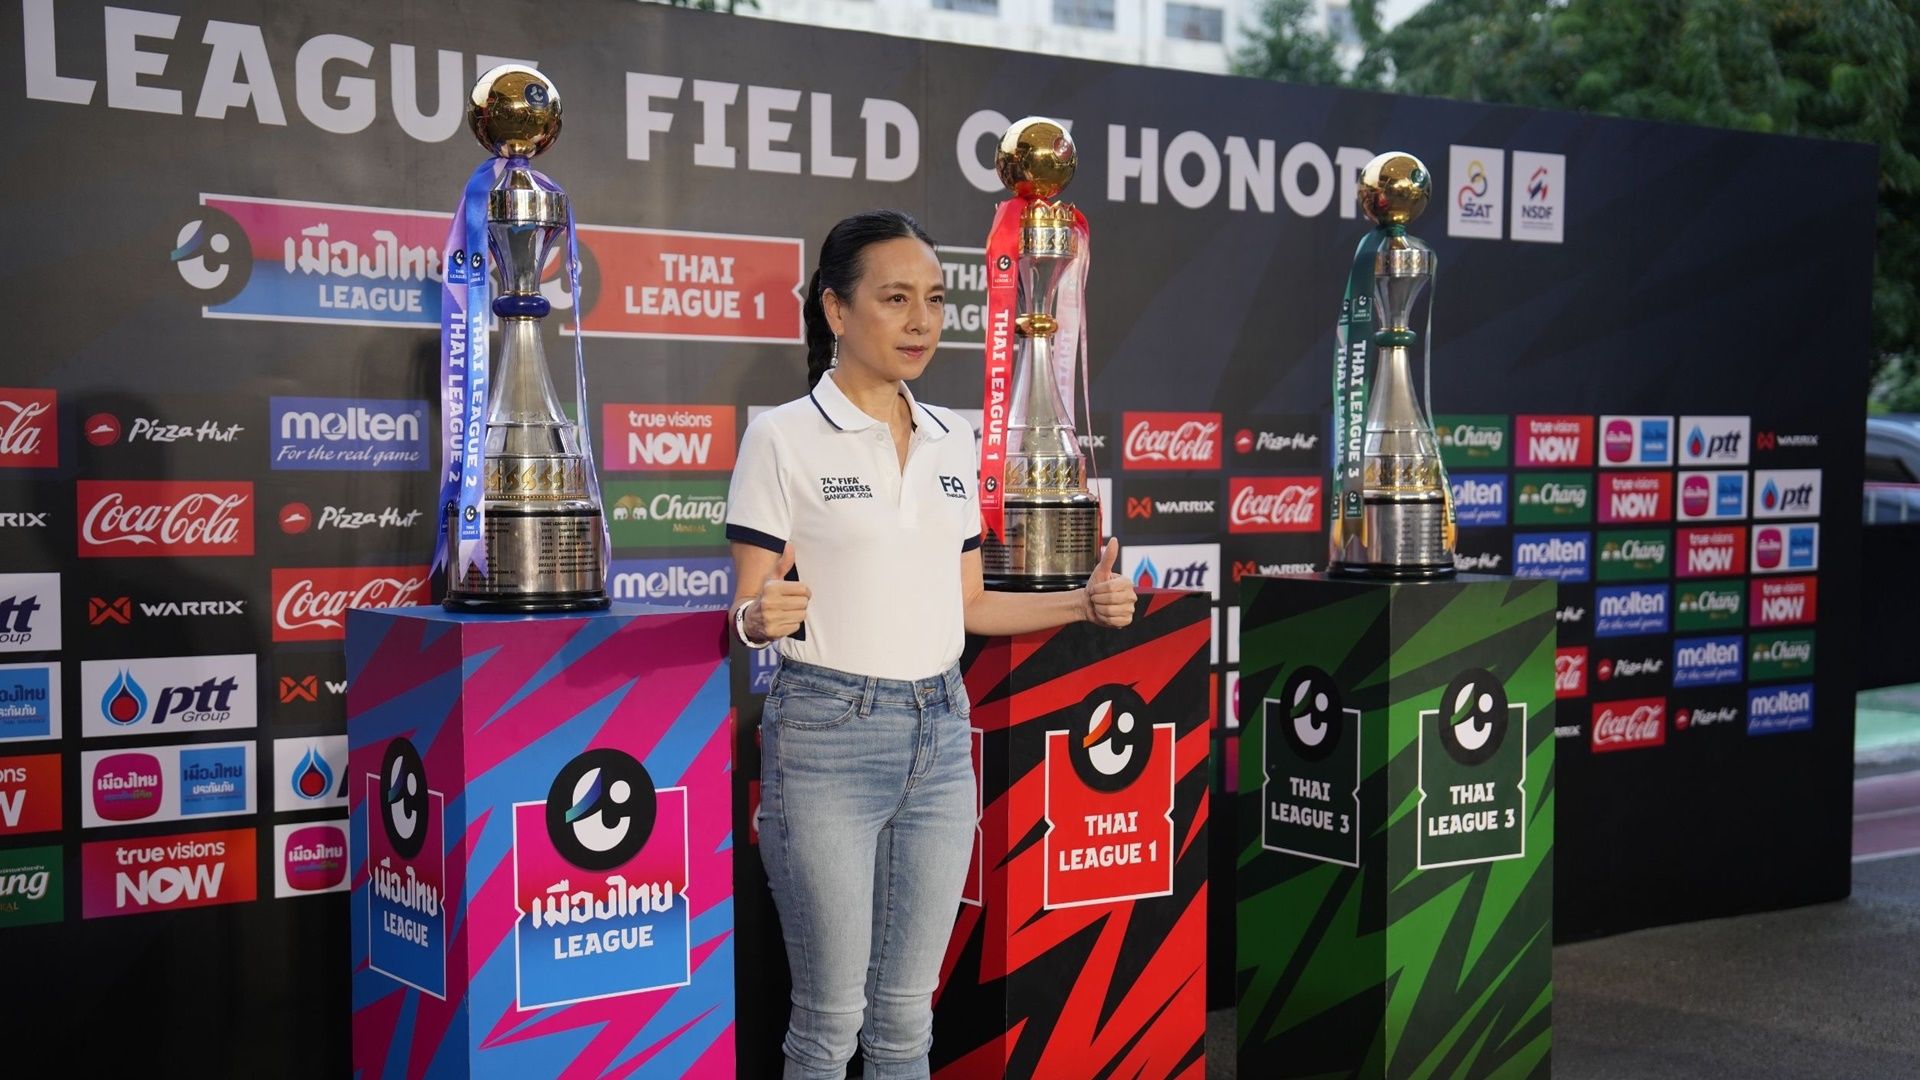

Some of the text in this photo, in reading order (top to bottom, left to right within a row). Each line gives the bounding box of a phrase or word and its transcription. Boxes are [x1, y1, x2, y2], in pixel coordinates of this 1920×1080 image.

[23, 0, 538, 143] LEAGU
[626, 71, 920, 182] FIELD
[1461, 202, 1493, 218] SAT
[1522, 204, 1553, 219] NSDF
[660, 253, 735, 285] THAI
[319, 285, 422, 313] LEAGUE
[625, 286, 765, 320] LEAGUE 1
[1336, 344, 1348, 390] THAI
[447, 309, 467, 483] THAI LEAGUE 2
[987, 309, 1009, 461] THAI LEAGUE 1
[465, 312, 484, 488] THAI LEAGUE 2
[1348, 339, 1366, 478] THAI LEAGUE 3
[128, 417, 245, 442] Pizza Hut
[281, 408, 419, 441] molten
[628, 411, 712, 427] true visions
[1530, 420, 1553, 434] true
[628, 432, 712, 465] NOW
[1125, 420, 1219, 461] Coca-Cola
[1255, 431, 1318, 451] Pizza Hut
[1454, 424, 1503, 450] Chang
[1529, 436, 1579, 462] NOW
[1707, 431, 1741, 458] ptt
[277, 444, 420, 465] For the real game
[823, 485, 871, 494] CONGRESS
[838, 477, 859, 485] FIFA
[939, 475, 966, 494] FA
[1452, 480, 1502, 505] olten
[1155, 501, 1215, 514] WARRIX
[1231, 486, 1319, 525] Coca-Cola
[1541, 483, 1587, 508] Chang
[1611, 493, 1658, 518] NOW
[1780, 484, 1813, 511] ptt
[82, 493, 248, 545] Coca-Cola
[317, 506, 423, 530] Pizza Hut
[650, 494, 726, 525] Chang
[1518, 538, 1585, 564] molten
[1622, 539, 1665, 563] Chang
[1688, 547, 1734, 572] NOW
[613, 566, 729, 598] molten
[1163, 561, 1208, 589] ptt
[140, 600, 244, 616] WARRIX
[1600, 592, 1664, 617] molten
[1699, 591, 1740, 614] Chang
[1761, 597, 1804, 621] NOW
[1677, 643, 1738, 668] molten
[1771, 640, 1811, 663] Chang
[152, 675, 239, 724] ptt
[1751, 691, 1809, 715] molten
[181, 710, 230, 723] Group
[1593, 704, 1662, 745] Coca-Cola
[1288, 777, 1331, 802] THAI
[1449, 781, 1495, 806] THAI
[1084, 811, 1139, 837] THAI
[1270, 801, 1350, 834] LEAGUE 3
[1427, 807, 1516, 837] LEAGUE 3
[116, 840, 225, 866] true visions
[1058, 841, 1157, 873] LEAGUE 1
[116, 862, 226, 908] NOW
[374, 855, 438, 918] เมืองไทย
[532, 874, 674, 930] เมืองไทย
[383, 910, 429, 948] LEAGUE
[554, 925, 654, 960] LEAGUE
